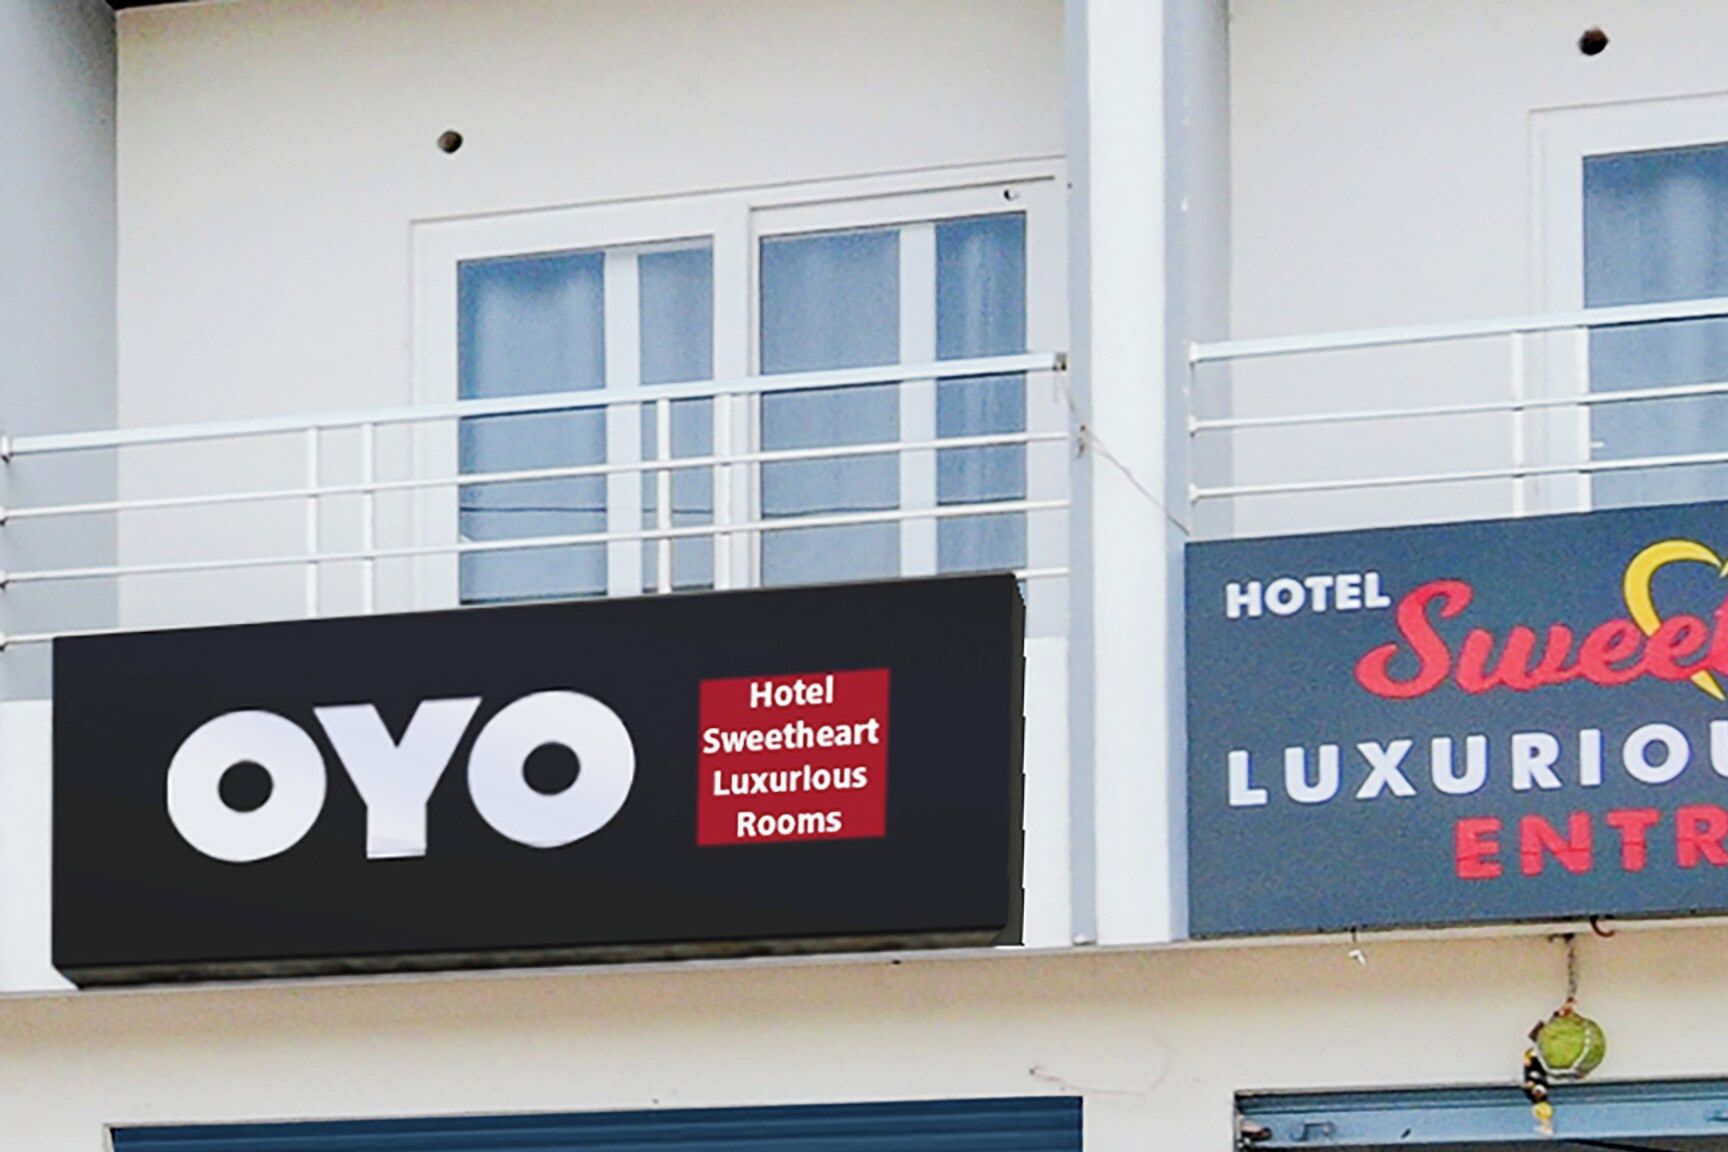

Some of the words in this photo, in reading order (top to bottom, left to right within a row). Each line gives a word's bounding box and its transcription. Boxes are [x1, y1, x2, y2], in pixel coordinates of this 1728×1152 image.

[1225, 572, 1392, 619] HOTEL
[749, 674, 834, 709] Hotel
[702, 717, 880, 754] Sweetheart
[167, 690, 637, 863] OYO
[736, 811, 843, 838] Rooms
